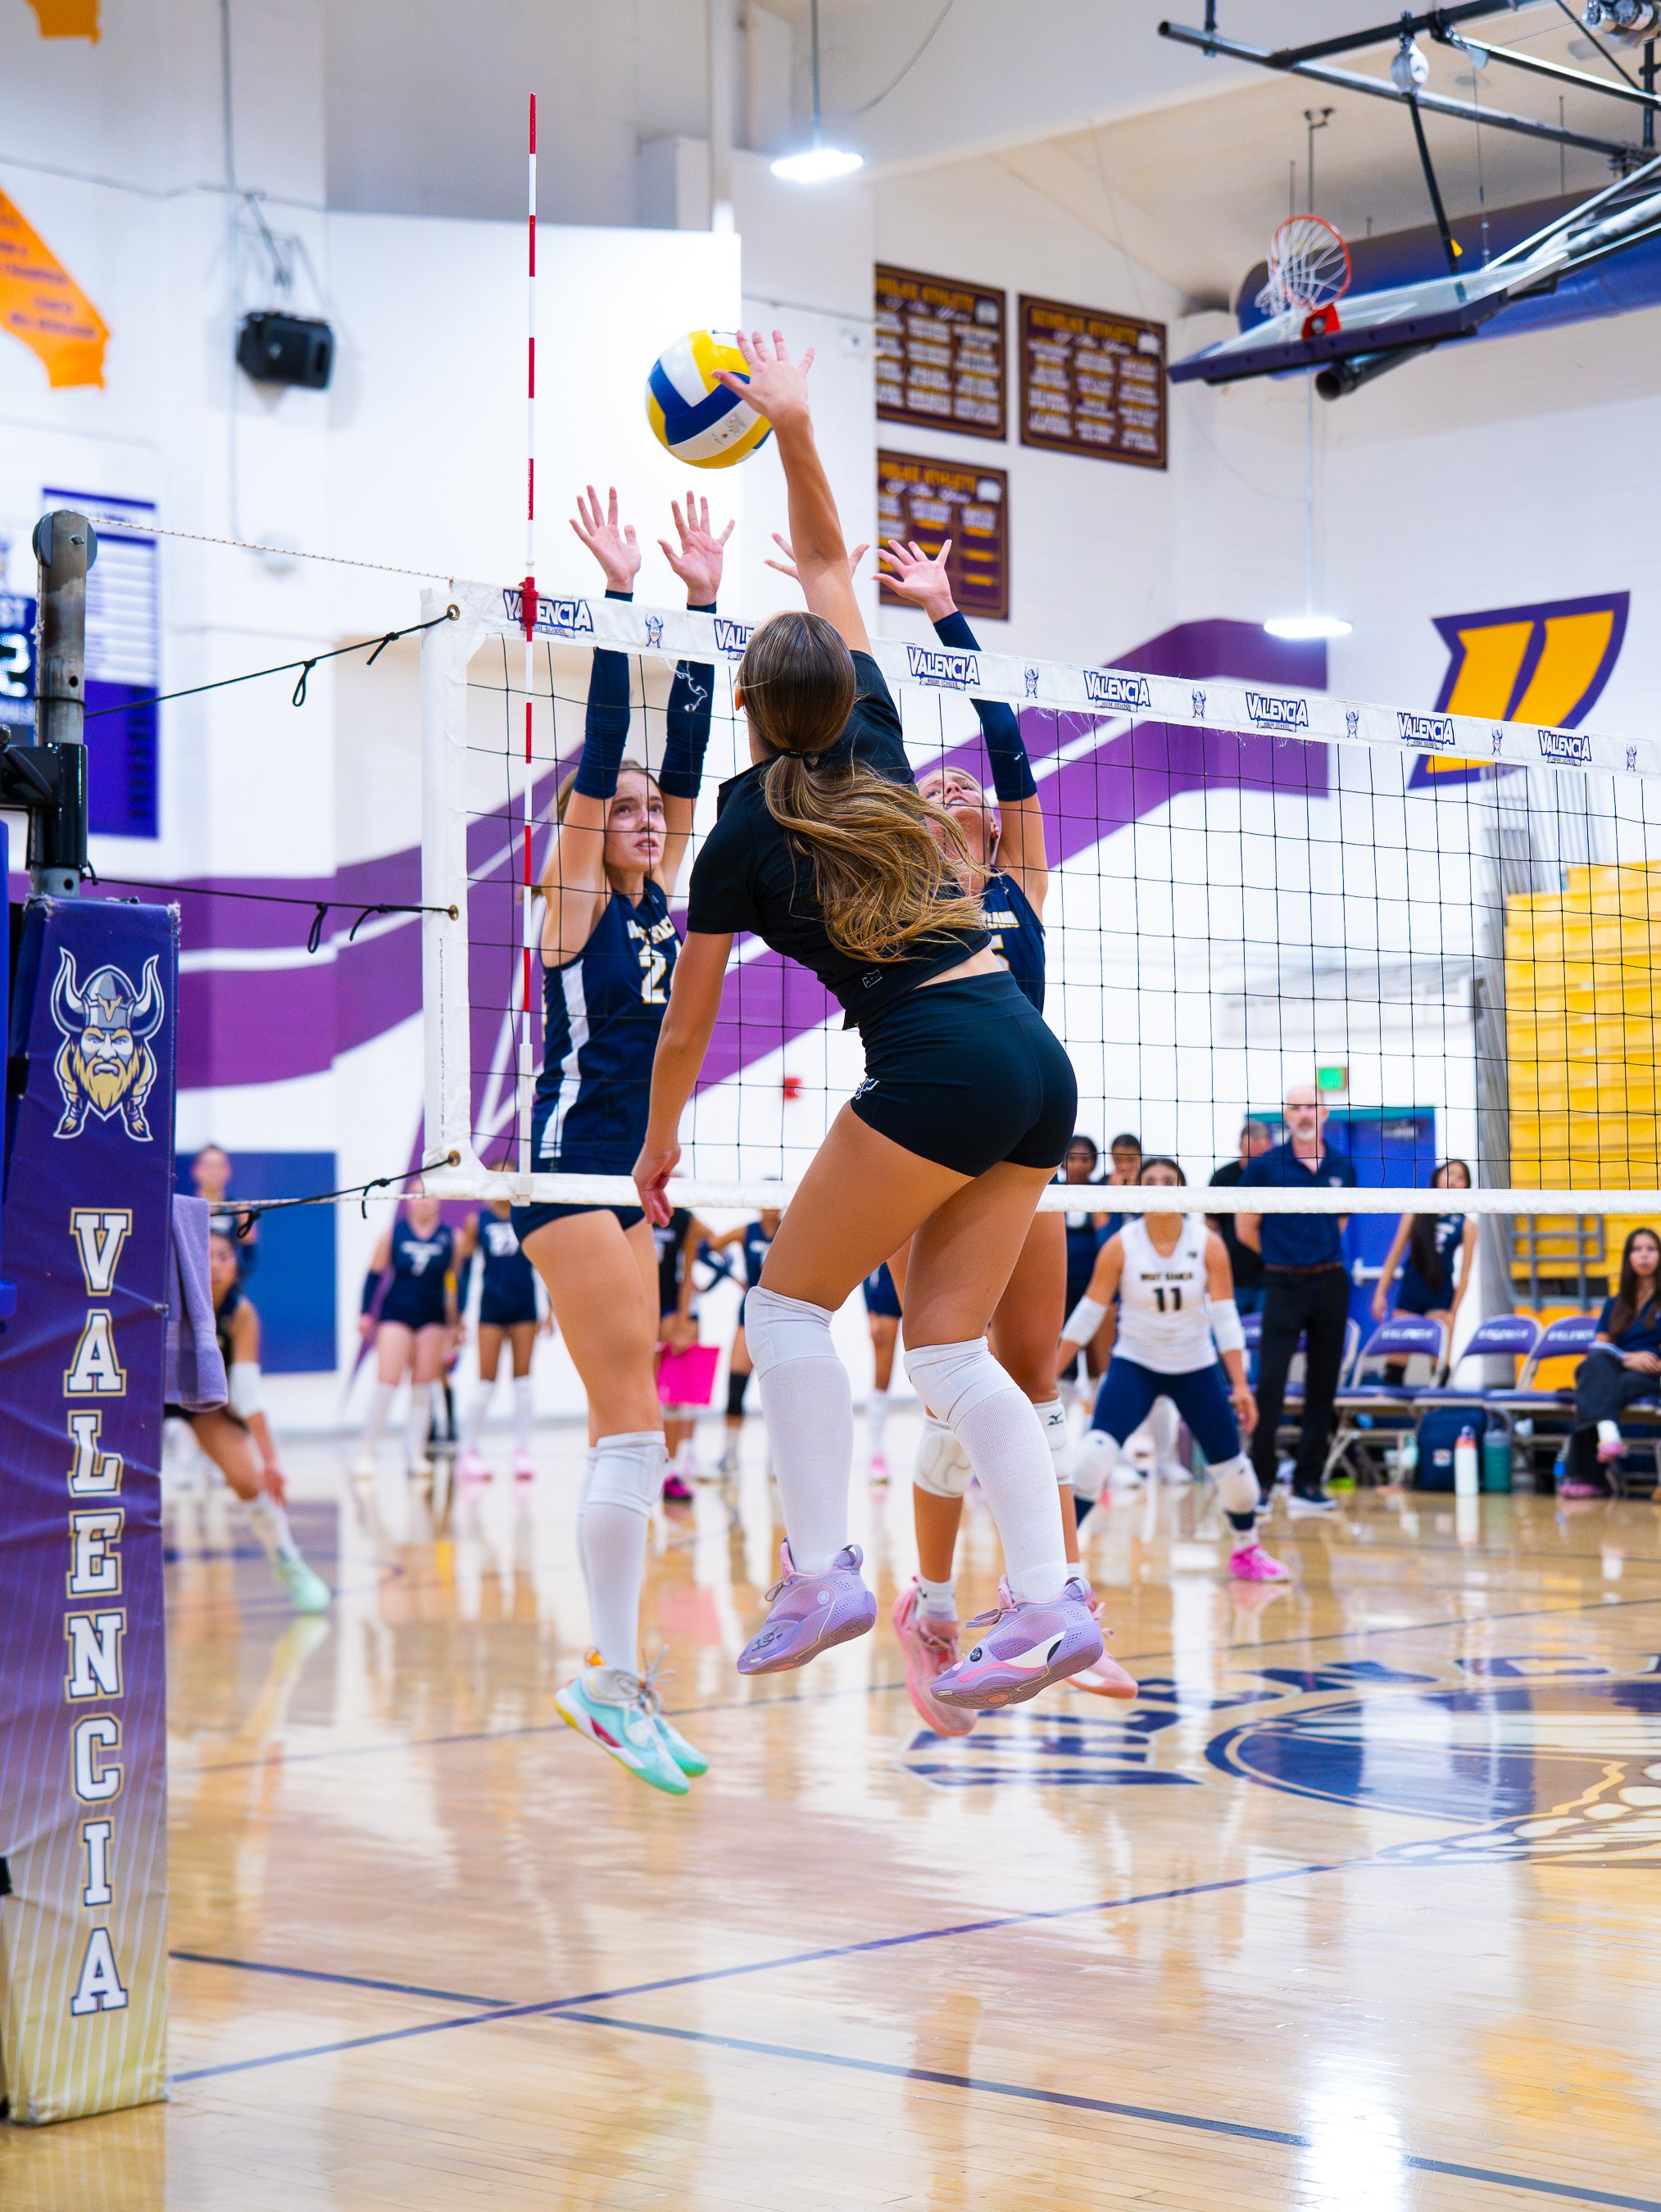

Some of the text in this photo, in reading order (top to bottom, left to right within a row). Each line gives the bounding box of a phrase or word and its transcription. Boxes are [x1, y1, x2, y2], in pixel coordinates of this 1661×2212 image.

[502, 588, 594, 632] VAENCIA
[906, 646, 980, 685] VALENCIA
[1082, 669, 1152, 707] VALENCIA
[1245, 691, 1309, 728] VALENCIA
[1396, 711, 1456, 746] VALENCIA
[1537, 728, 1592, 762] VALENCIA
[1153, 1287, 1182, 1312] 11
[63, 1207, 133, 2017] VALENCIA
